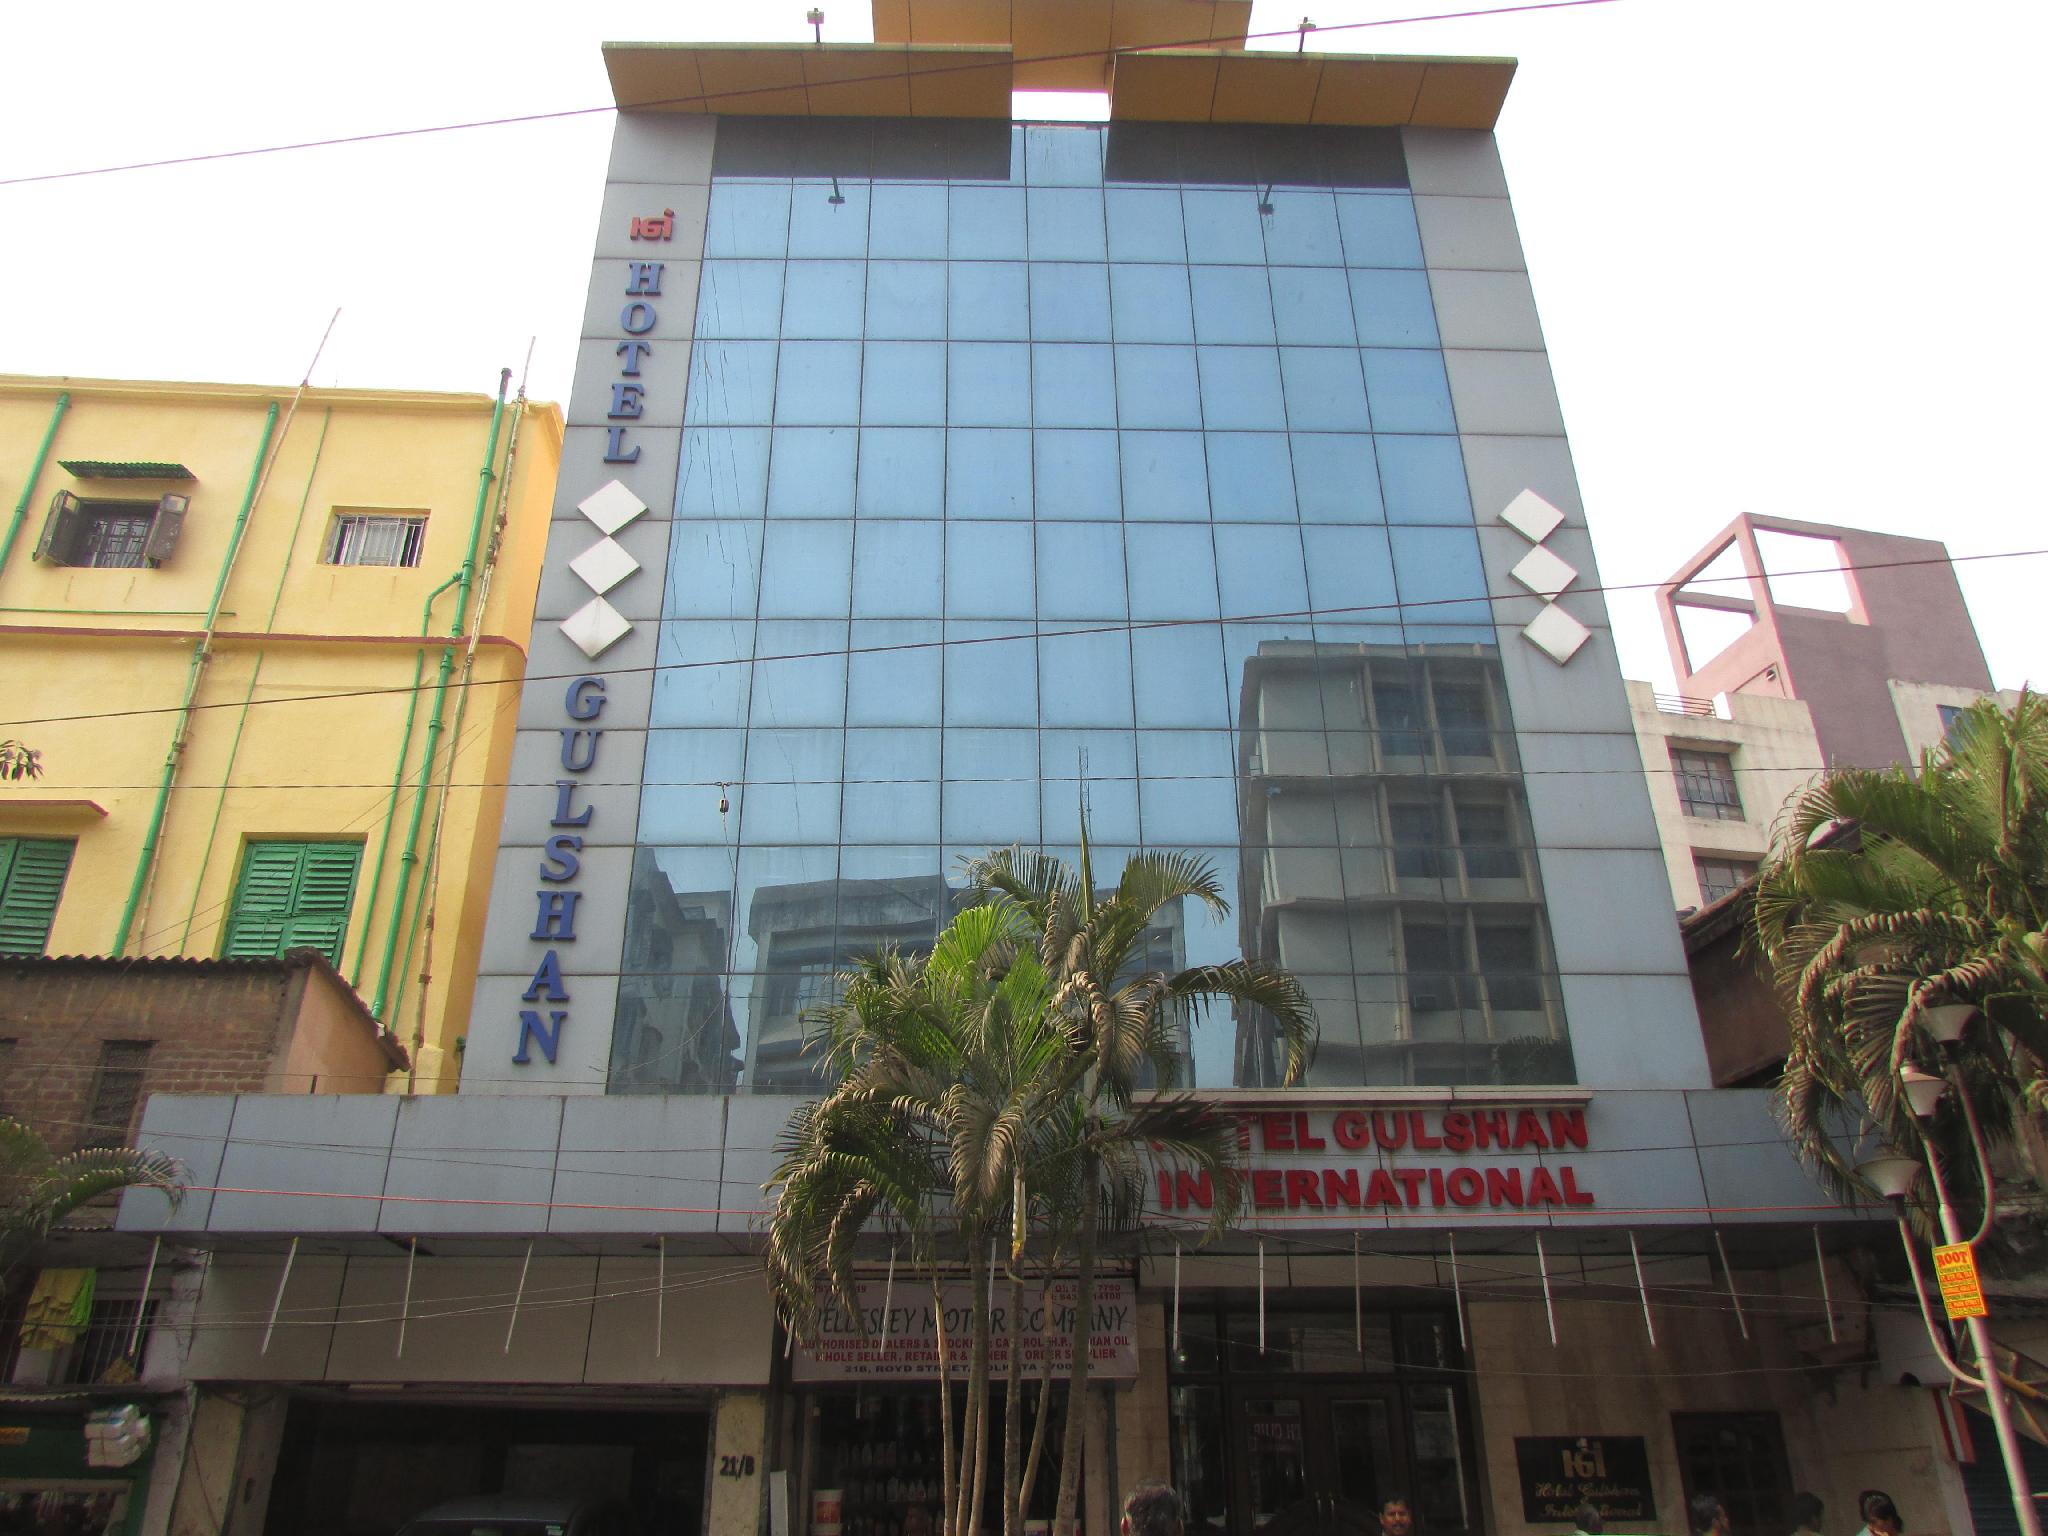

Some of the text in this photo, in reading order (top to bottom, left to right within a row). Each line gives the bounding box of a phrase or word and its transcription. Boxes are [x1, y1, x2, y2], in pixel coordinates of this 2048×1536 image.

[602, 262, 665, 464] HOTEL
[512, 677, 608, 1065] GULSHAN
[1333, 1109, 1589, 1150] GULSHAN
[875, 1364, 912, 1373] ROYD
